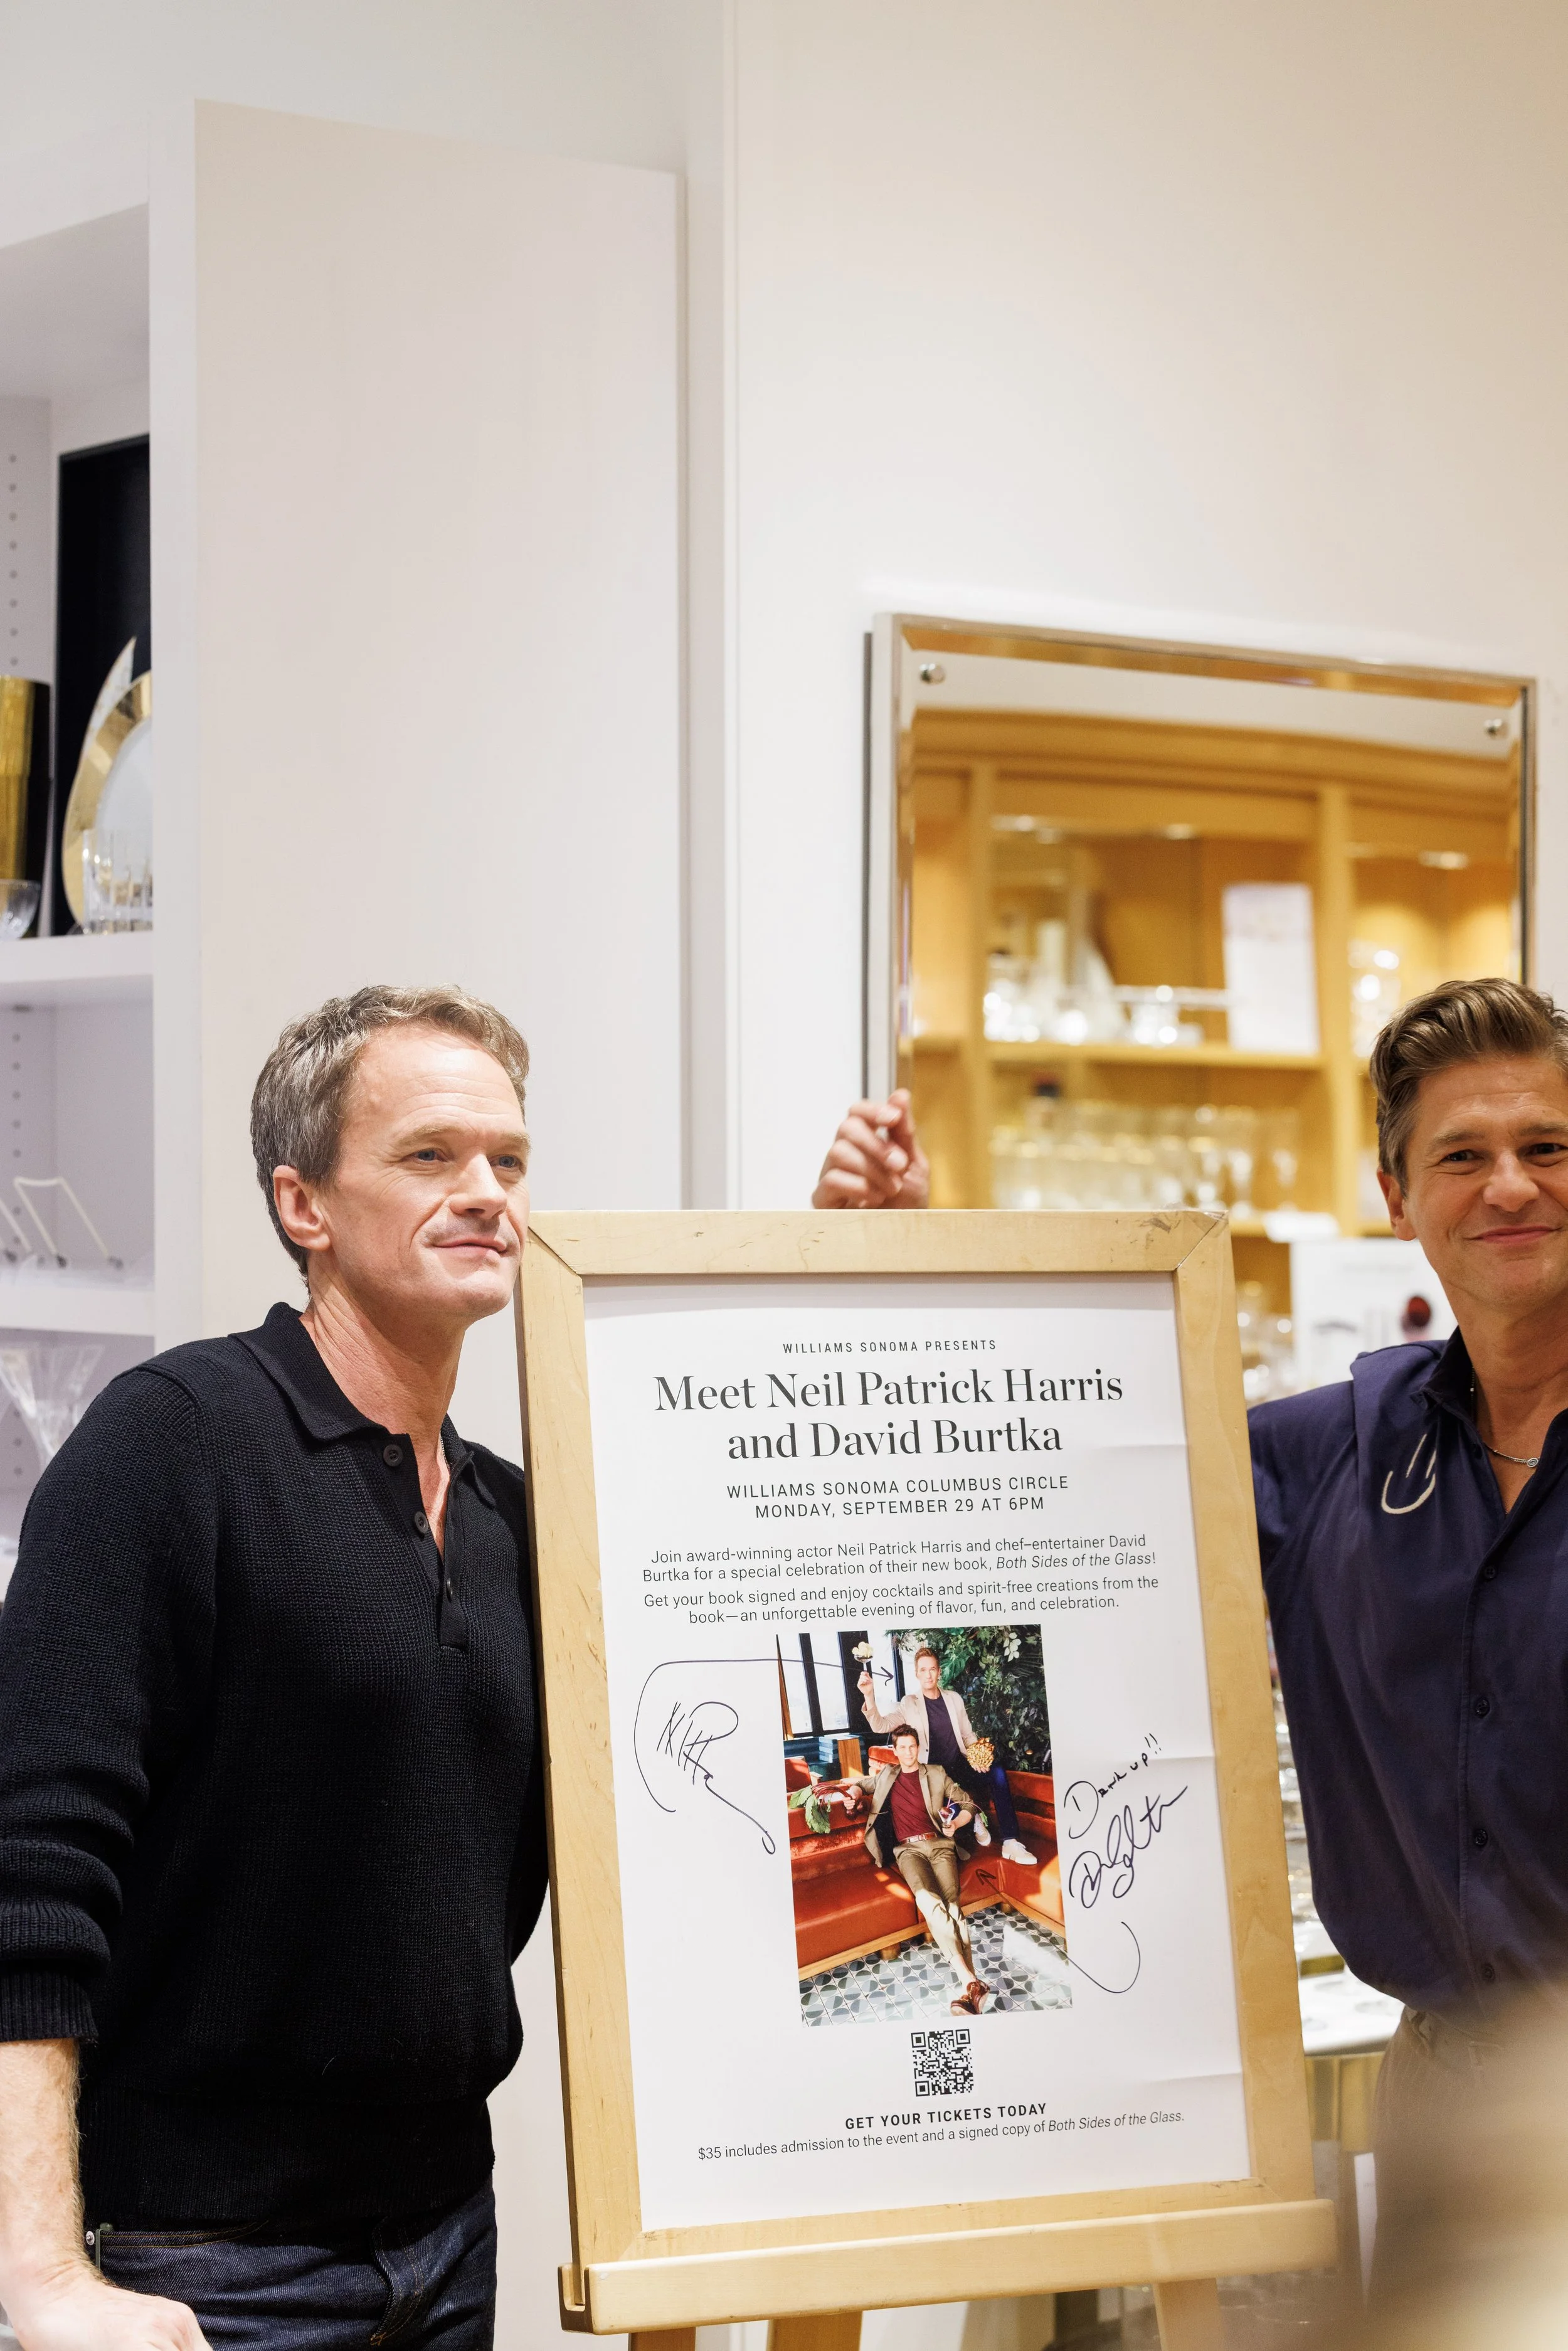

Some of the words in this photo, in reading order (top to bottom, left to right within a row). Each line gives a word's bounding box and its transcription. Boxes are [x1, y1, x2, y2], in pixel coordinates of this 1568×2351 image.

[783, 1342, 852, 1354] WILLIAMS
[860, 1341, 918, 1352] SONOMA
[925, 1339, 995, 1351] PRESENTS
[653, 1376, 757, 1411] Meet
[765, 1371, 846, 1408] Neil
[856, 1369, 995, 1406] Patrick
[1003, 1368, 1123, 1402] Harris
[728, 1423, 799, 1460] and
[808, 1420, 923, 1457] David
[931, 1417, 1064, 1453] Burtka
[726, 1483, 815, 1499] WILLIAMS
[823, 1480, 899, 1495] SONOMA
[906, 1477, 1002, 1493] COLUMBUS
[1009, 1475, 1068, 1490] CIRCLE
[755, 1502, 835, 1519] MONDAY,
[842, 1499, 948, 1515] SEPTEMBER
[955, 1499, 973, 1512] 29
[982, 1497, 1002, 1511] AT
[1009, 1497, 1044, 1510] 6PM
[651, 1550, 682, 1564] Join
[687, 1546, 792, 1562] award-winning
[797, 1546, 833, 1558] actor
[837, 1542, 864, 1556] Neil
[869, 1541, 917, 1556] Patrick
[921, 1540, 962, 1553] Harris
[967, 1538, 991, 1552] and
[1109, 1534, 1146, 1547] David
[643, 1568, 689, 1582] Burtka
[694, 1566, 713, 1580] for
[718, 1569, 726, 1579] a
[731, 1564, 781, 1582] special
[786, 1561, 864, 1577] celebration
[869, 1559, 883, 1574] of
[886, 1559, 918, 1573] their
[922, 1561, 950, 1571] new
[954, 1556, 992, 1571] book,
[997, 1555, 1027, 1569] Both
[1031, 1554, 1067, 1568] Sides
[1072, 1553, 1086, 1567] of
[1089, 1553, 1110, 1566] the
[1115, 1552, 1155, 1565] Glass!
[644, 1594, 669, 1607] Get
[672, 1595, 704, 1610] your
[709, 1590, 744, 1605] book
[748, 1588, 795, 1606] signed
[800, 1586, 826, 1601] and
[831, 1586, 868, 1602] enjoy
[872, 1583, 934, 1598] cocktails
[938, 1581, 963, 1596] and
[968, 1580, 1032, 1598] spirit-free
[1037, 1578, 1099, 1592] creations
[1102, 1576, 1133, 1589] from
[1137, 1575, 1158, 1589] the
[762, 1604, 857, 1623] unforgettable
[861, 1603, 914, 1618] evening
[919, 1601, 933, 1615] of
[936, 1600, 977, 1615] flavor,
[980, 1599, 1006, 1613] fun,
[1011, 1597, 1036, 1611] and
[1040, 1595, 1119, 1610] celebration.
[845, 2116, 874, 2130] GET
[880, 2113, 921, 2127] YOUR
[926, 2107, 992, 2123] TICKETS
[997, 2103, 1046, 2118] TODAY
[698, 2147, 721, 2161] $35
[725, 2142, 777, 2158] includes
[781, 2138, 844, 2153] admission
[847, 2137, 860, 2148] to
[862, 2134, 882, 2147] the
[886, 2132, 919, 2145] event
[922, 2128, 945, 2142] and
[948, 2131, 955, 2140] a
[958, 2124, 999, 2141] signed
[1002, 2125, 1030, 2137] copy
[1034, 2120, 1046, 2133] of
[1048, 2118, 1075, 2131] Both
[1079, 2116, 1111, 2130] Sides
[1114, 2113, 1127, 2126] of
[1128, 2113, 1147, 2125] the
[1150, 2111, 1184, 2123] Glass.
